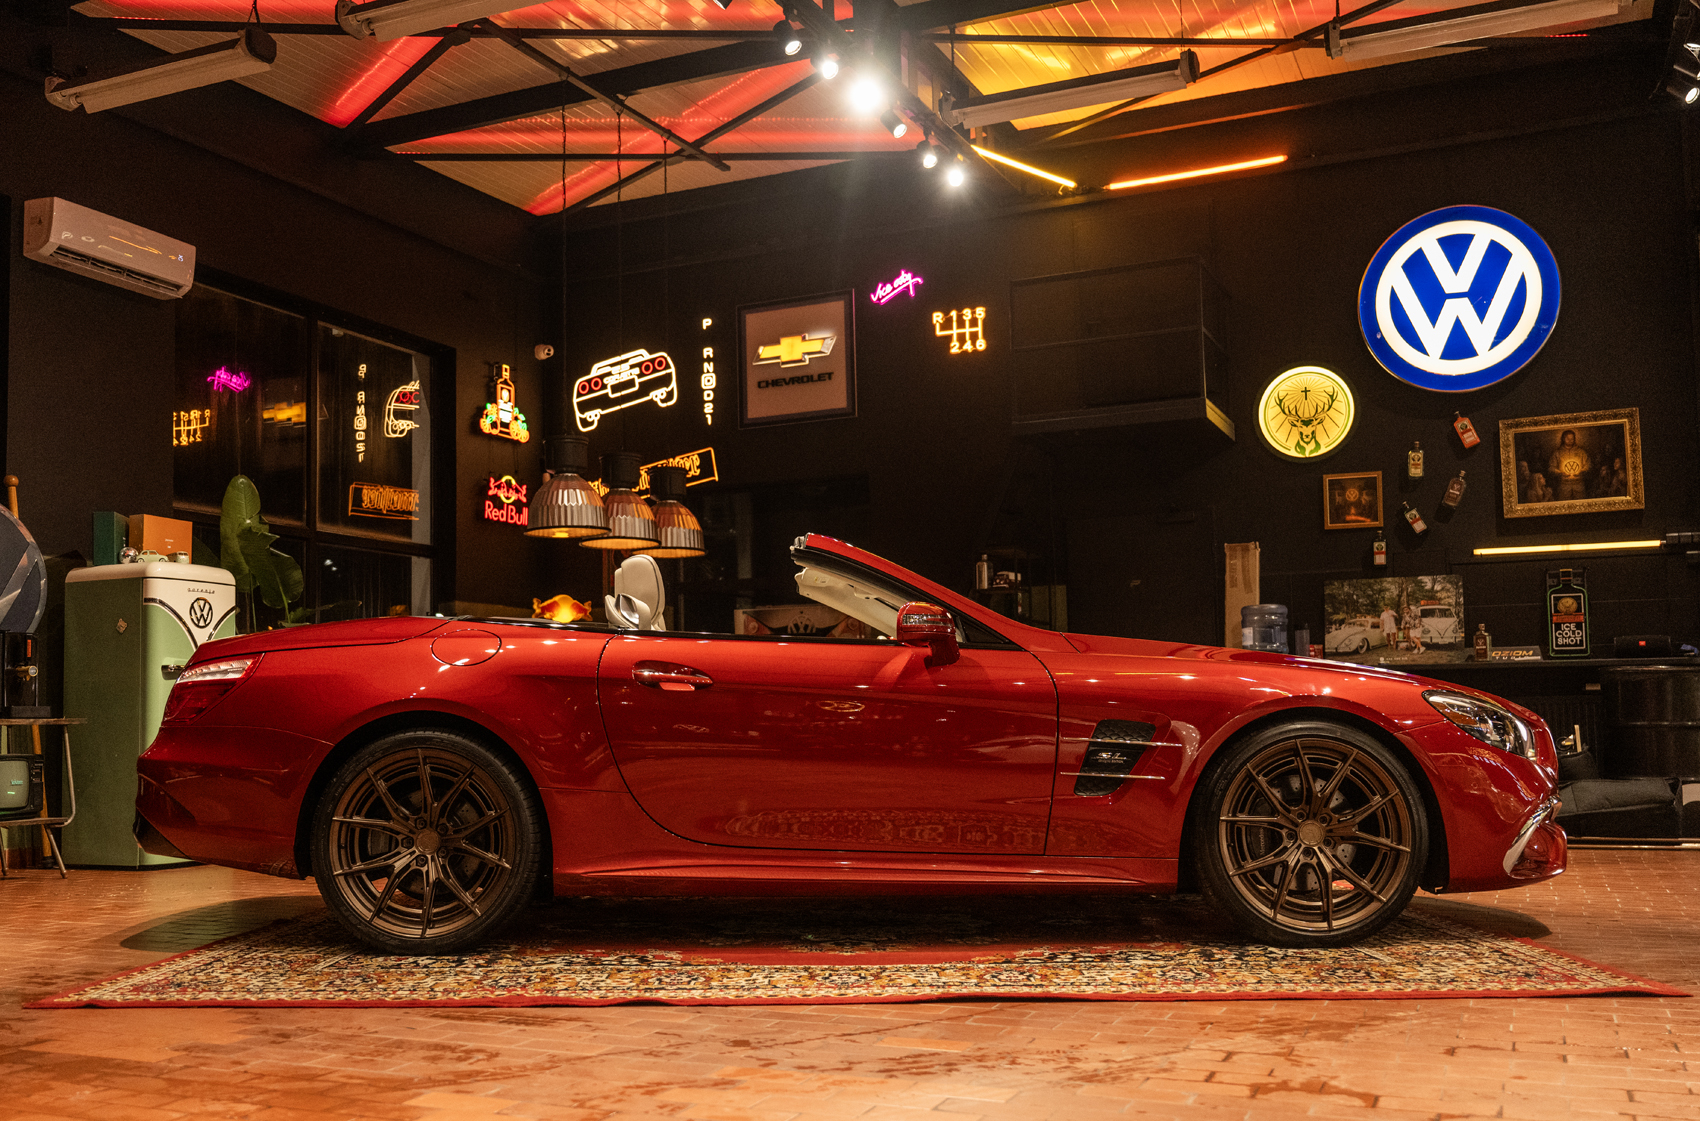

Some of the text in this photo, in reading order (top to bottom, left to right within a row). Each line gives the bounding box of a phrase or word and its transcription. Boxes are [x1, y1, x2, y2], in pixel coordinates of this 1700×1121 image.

[1376, 220, 1542, 376] VW
[932, 311, 944, 324] R
[962, 307, 972, 320] 3
[975, 307, 986, 319] 5
[949, 339, 986, 354] 2 4 6
[757, 372, 834, 389] CHEVROLET
[485, 500, 529, 526] Red Bull
[1556, 630, 1582, 638] COLD
[1561, 623, 1576, 631] ICE
[1557, 637, 1582, 645] SHOT
